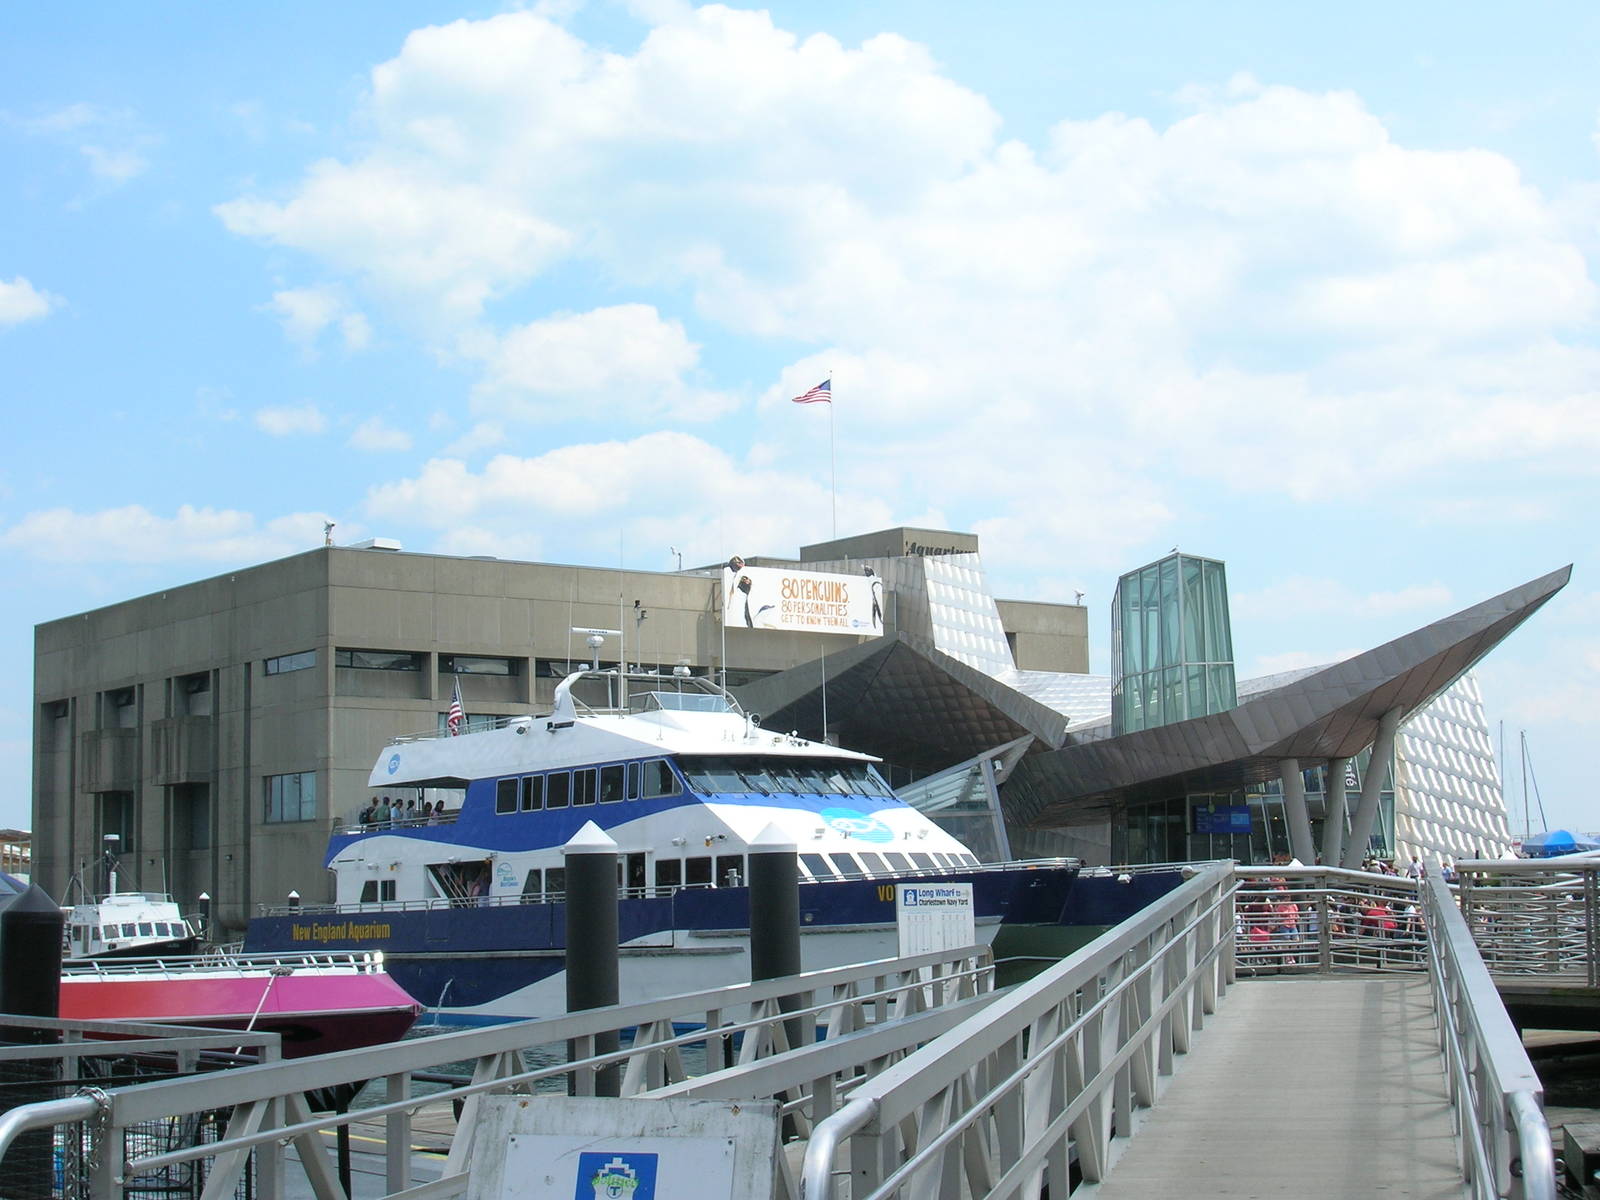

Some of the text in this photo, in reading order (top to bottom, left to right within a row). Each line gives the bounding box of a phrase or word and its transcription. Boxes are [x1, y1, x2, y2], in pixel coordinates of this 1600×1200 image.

[909, 542, 976, 557] Aquari
[781, 578, 799, 599] 80
[781, 599, 792, 612] 80
[781, 614, 793, 623] GET
[796, 614, 805, 623] TO
[806, 615, 821, 625] KNOW
[823, 616, 838, 626] THEM
[918, 889, 934, 898] Long
[935, 889, 955, 897] Wharf
[947, 899, 957, 907] Navy
[958, 898, 968, 906] Yard
[292, 920, 391, 944] New England Aquarium
